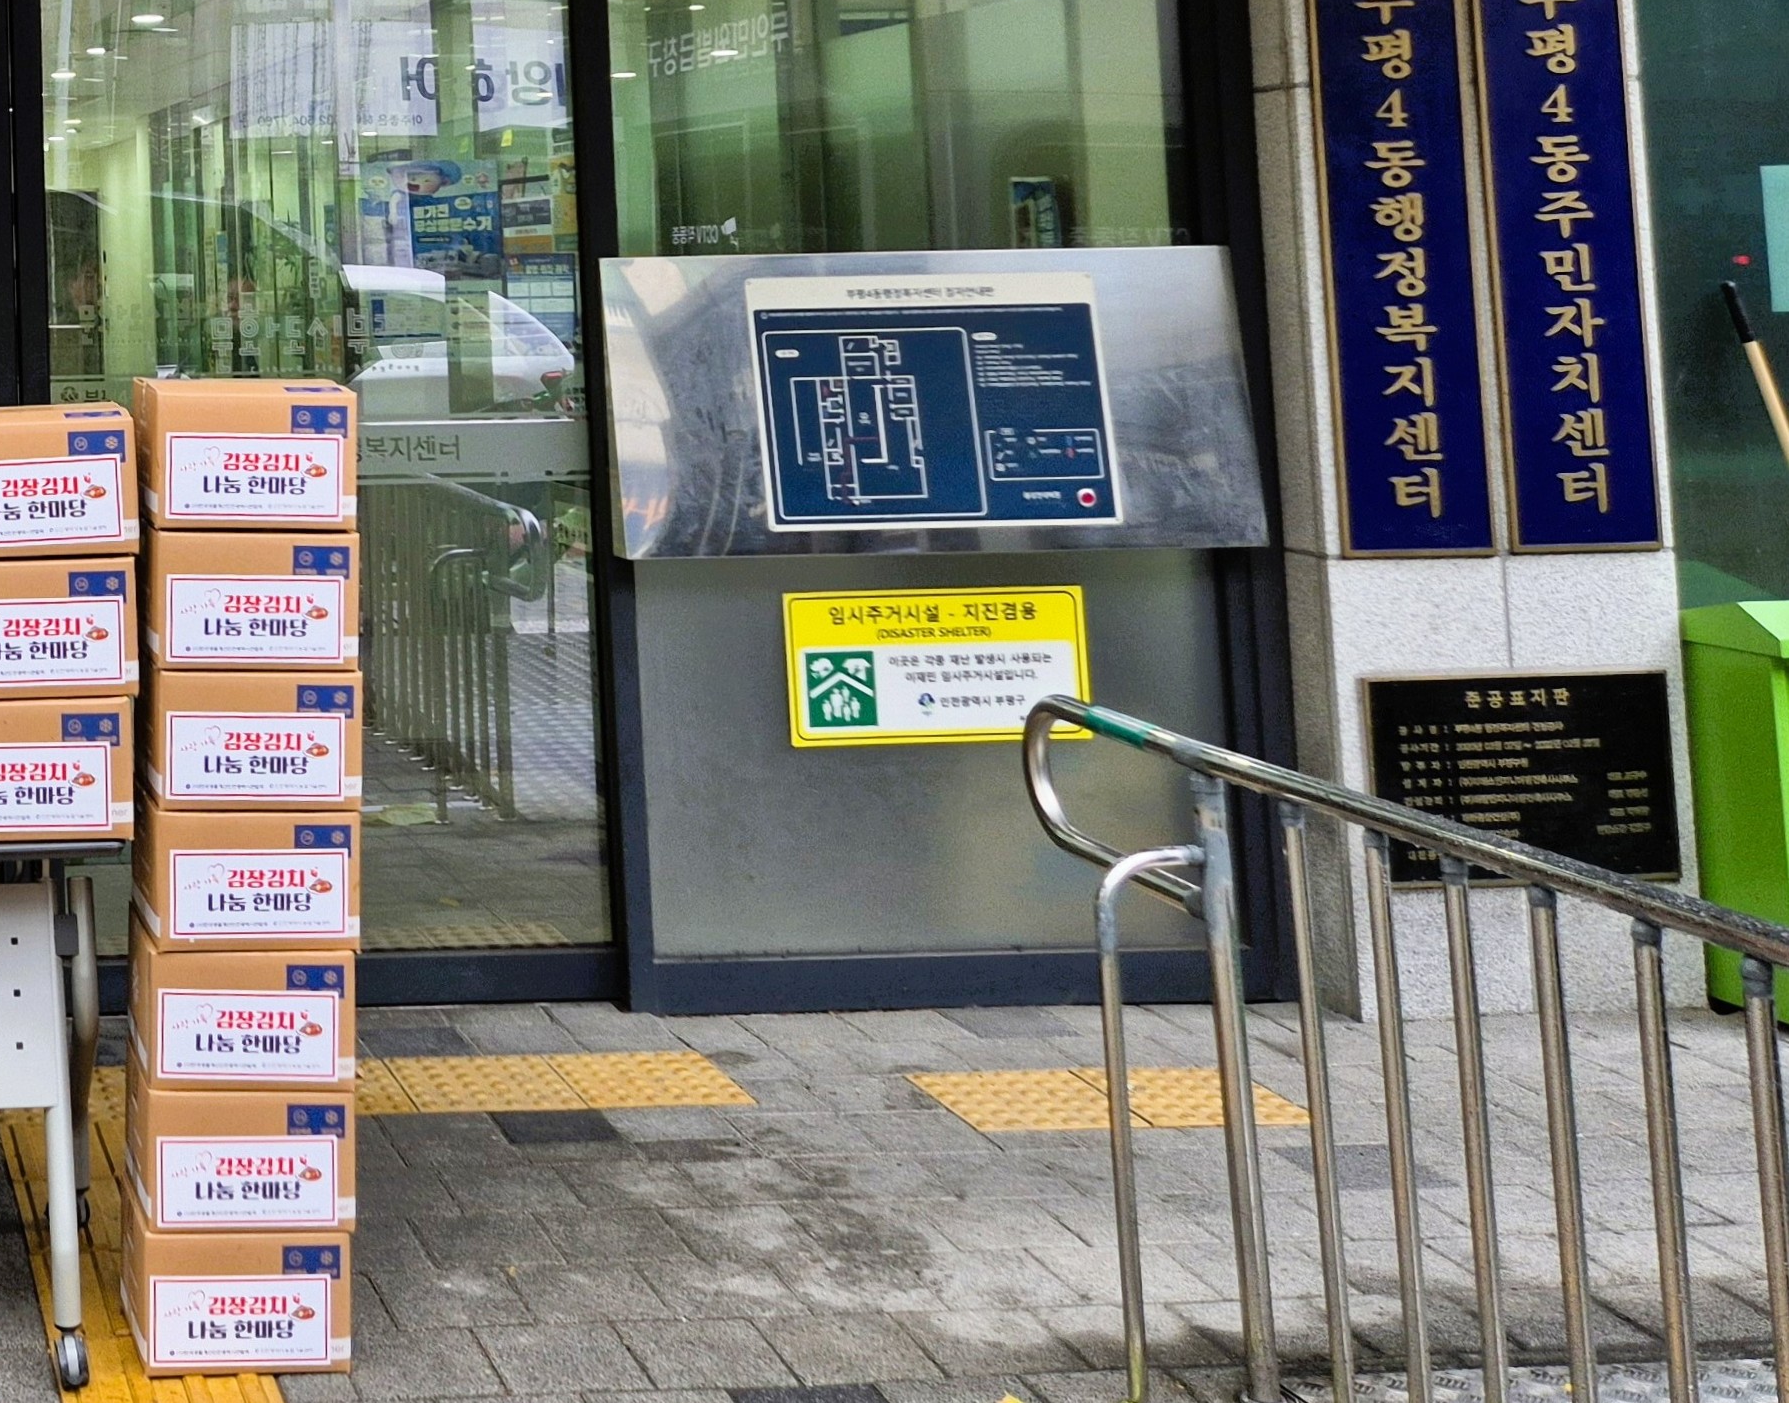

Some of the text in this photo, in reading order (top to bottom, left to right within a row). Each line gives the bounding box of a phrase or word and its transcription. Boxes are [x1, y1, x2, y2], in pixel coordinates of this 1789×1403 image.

[223, 453, 300, 472] 김장김치
[2, 476, 79, 498] 김장김치
[203, 475, 307, 495] 나눔 한마당
[28, 499, 86, 520] 한마당
[224, 595, 301, 614] 김장김치
[828, 600, 1038, 626] 임시주거시설 지진겸용
[3, 617, 81, 638] 김장김치
[204, 617, 308, 637] 나눔 한마당
[876, 625, 993, 641] (DISASTER SHELTER)
[29, 640, 88, 660] 한마당
[949, 654, 970, 665] 재난
[974, 652, 1007, 665] 발생시
[1011, 651, 1053, 664] 사용되는
[940, 696, 993, 709] 인천광역시
[224, 732, 302, 752] 김장김치
[204, 755, 309, 775] 나눔 한마당
[14, 786, 75, 805] 한마당
[228, 869, 306, 888] 김장김치
[207, 892, 312, 912] 나눔 한마당
[217, 1011, 295, 1030] 김장김치
[195, 1033, 302, 1054] 나눔 한마당
[216, 1157, 294, 1176] 김장김치
[195, 1181, 301, 1200] 나눔 한마당
[209, 1296, 288, 1316] 김장김치
[188, 1319, 294, 1340] 나눔 한마당
